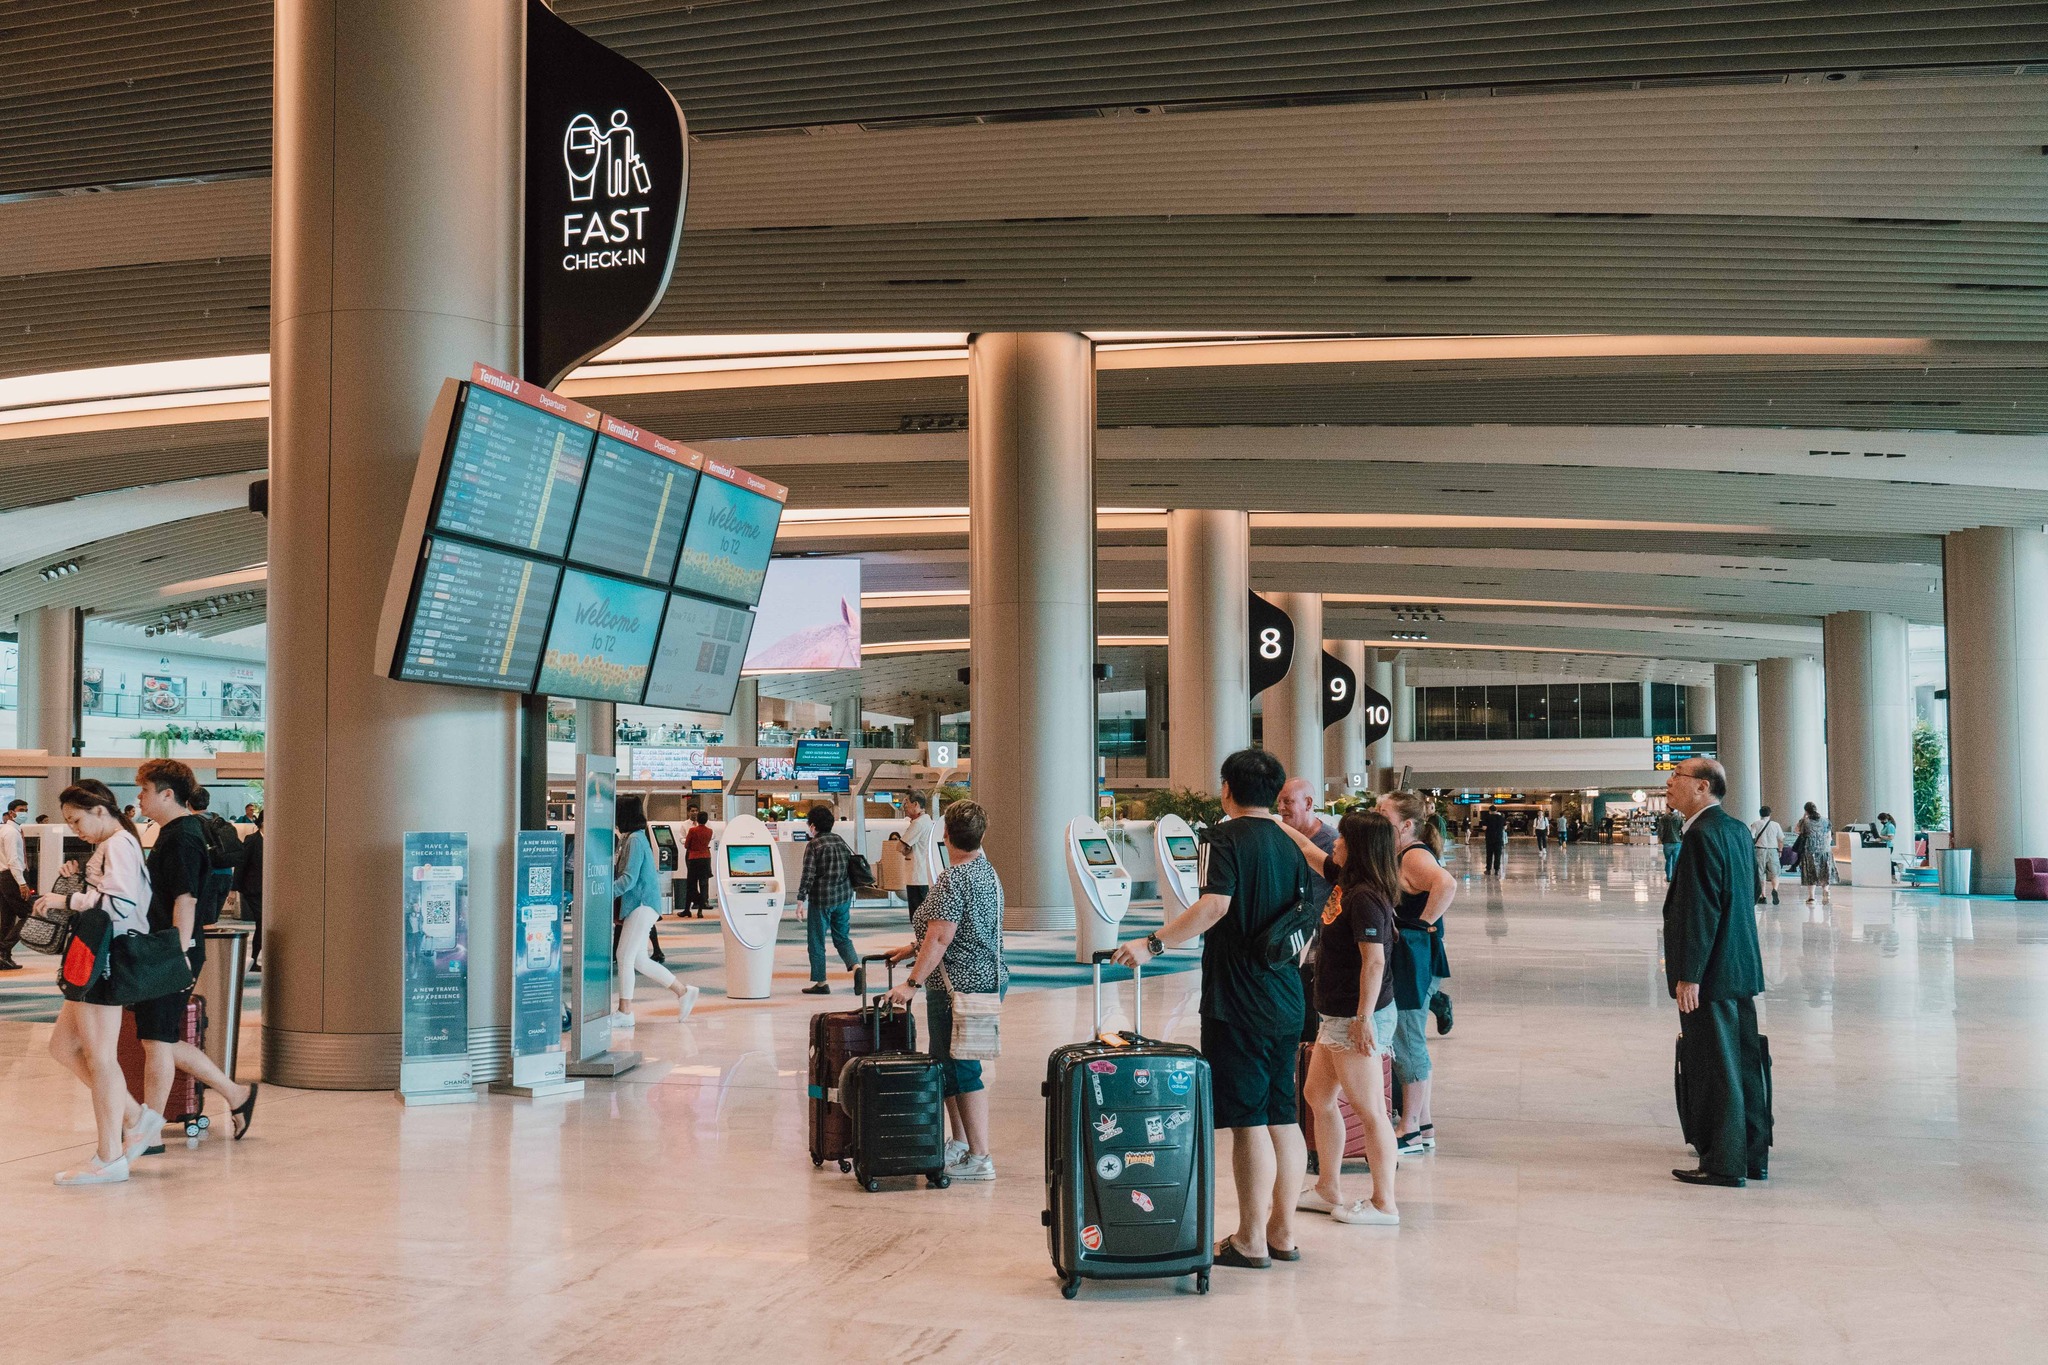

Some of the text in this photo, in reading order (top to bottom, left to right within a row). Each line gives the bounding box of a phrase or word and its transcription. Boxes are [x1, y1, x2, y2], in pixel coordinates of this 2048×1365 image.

[564, 207, 650, 246] FAST
[563, 248, 646, 270] CHECK-IN
[480, 368, 520, 395] Terminal 2
[540, 394, 567, 413] Departures
[607, 420, 639, 442] Terminal 2
[654, 440, 677, 456] Departures
[710, 460, 736, 480] Terminal 2
[748, 477, 766, 490] Departures
[708, 503, 760, 540] Welcome
[720, 536, 740, 555] to T2
[576, 597, 640, 633] Welcome
[592, 633, 616, 652] to T2
[1260, 628, 1282, 659] 8
[1330, 678, 1347, 701] 9
[1366, 706, 1389, 725] 10
[937, 746, 949, 764] 8
[1354, 775, 1361, 786] 9
[661, 850, 668, 862] 3
[591, 880, 605, 895] CLASS
[1100, 1128, 1122, 1140] adidas
